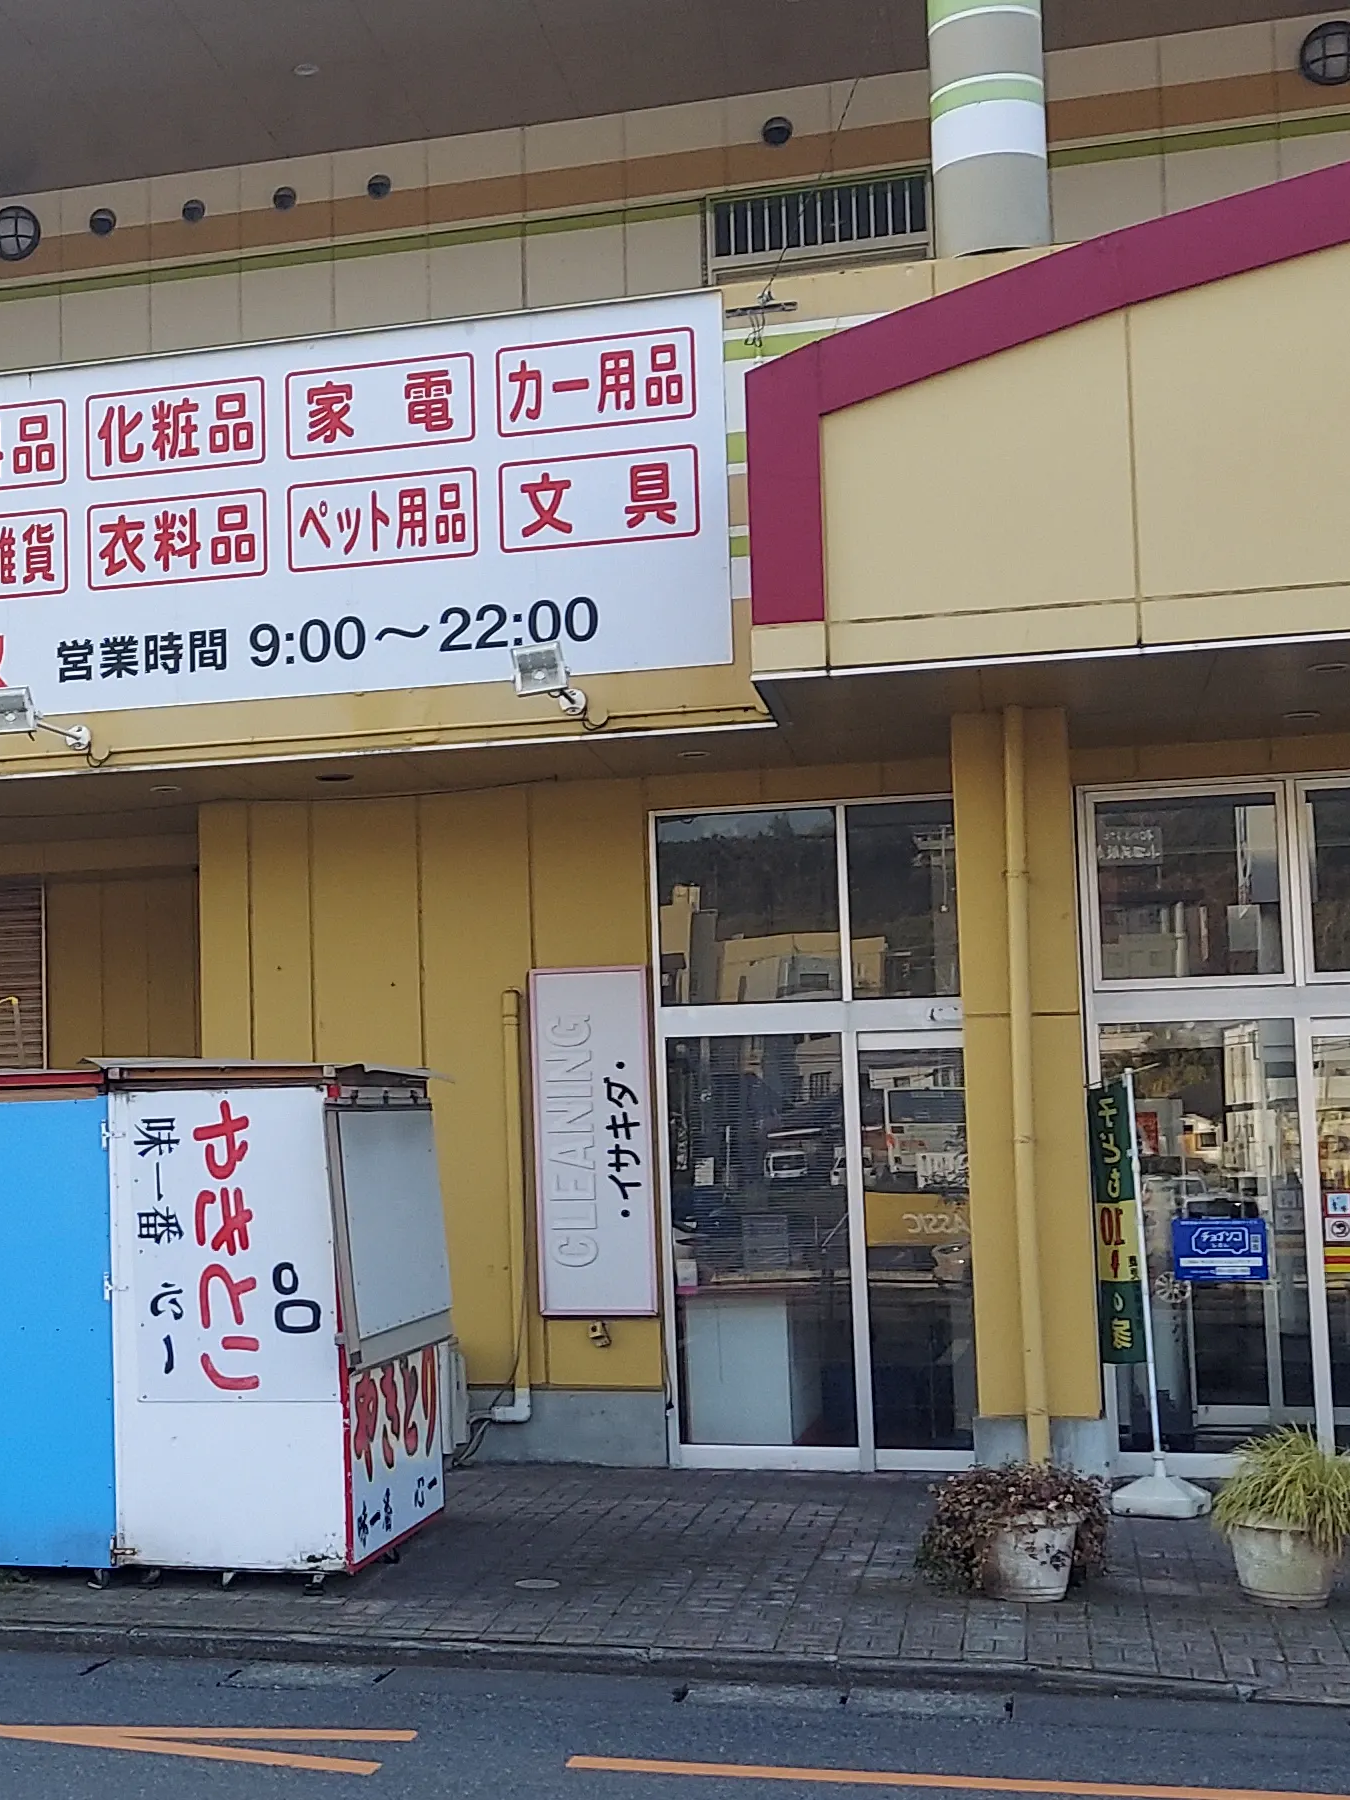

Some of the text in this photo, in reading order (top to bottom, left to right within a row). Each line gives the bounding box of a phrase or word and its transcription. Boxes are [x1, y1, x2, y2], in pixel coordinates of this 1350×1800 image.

[306, 369, 454, 445] 家電
[508, 343, 683, 422] カー用品
[97, 391, 254, 467] 化粧品
[299, 481, 467, 555] ペット用品
[519, 461, 678, 538] 文具
[97, 503, 256, 579] 衣料品
[56, 628, 228, 683] 営業時間
[545, 1013, 599, 1269] CLEANING
[133, 1117, 185, 1245] 味一番
[192, 1100, 260, 1392] やきとり
